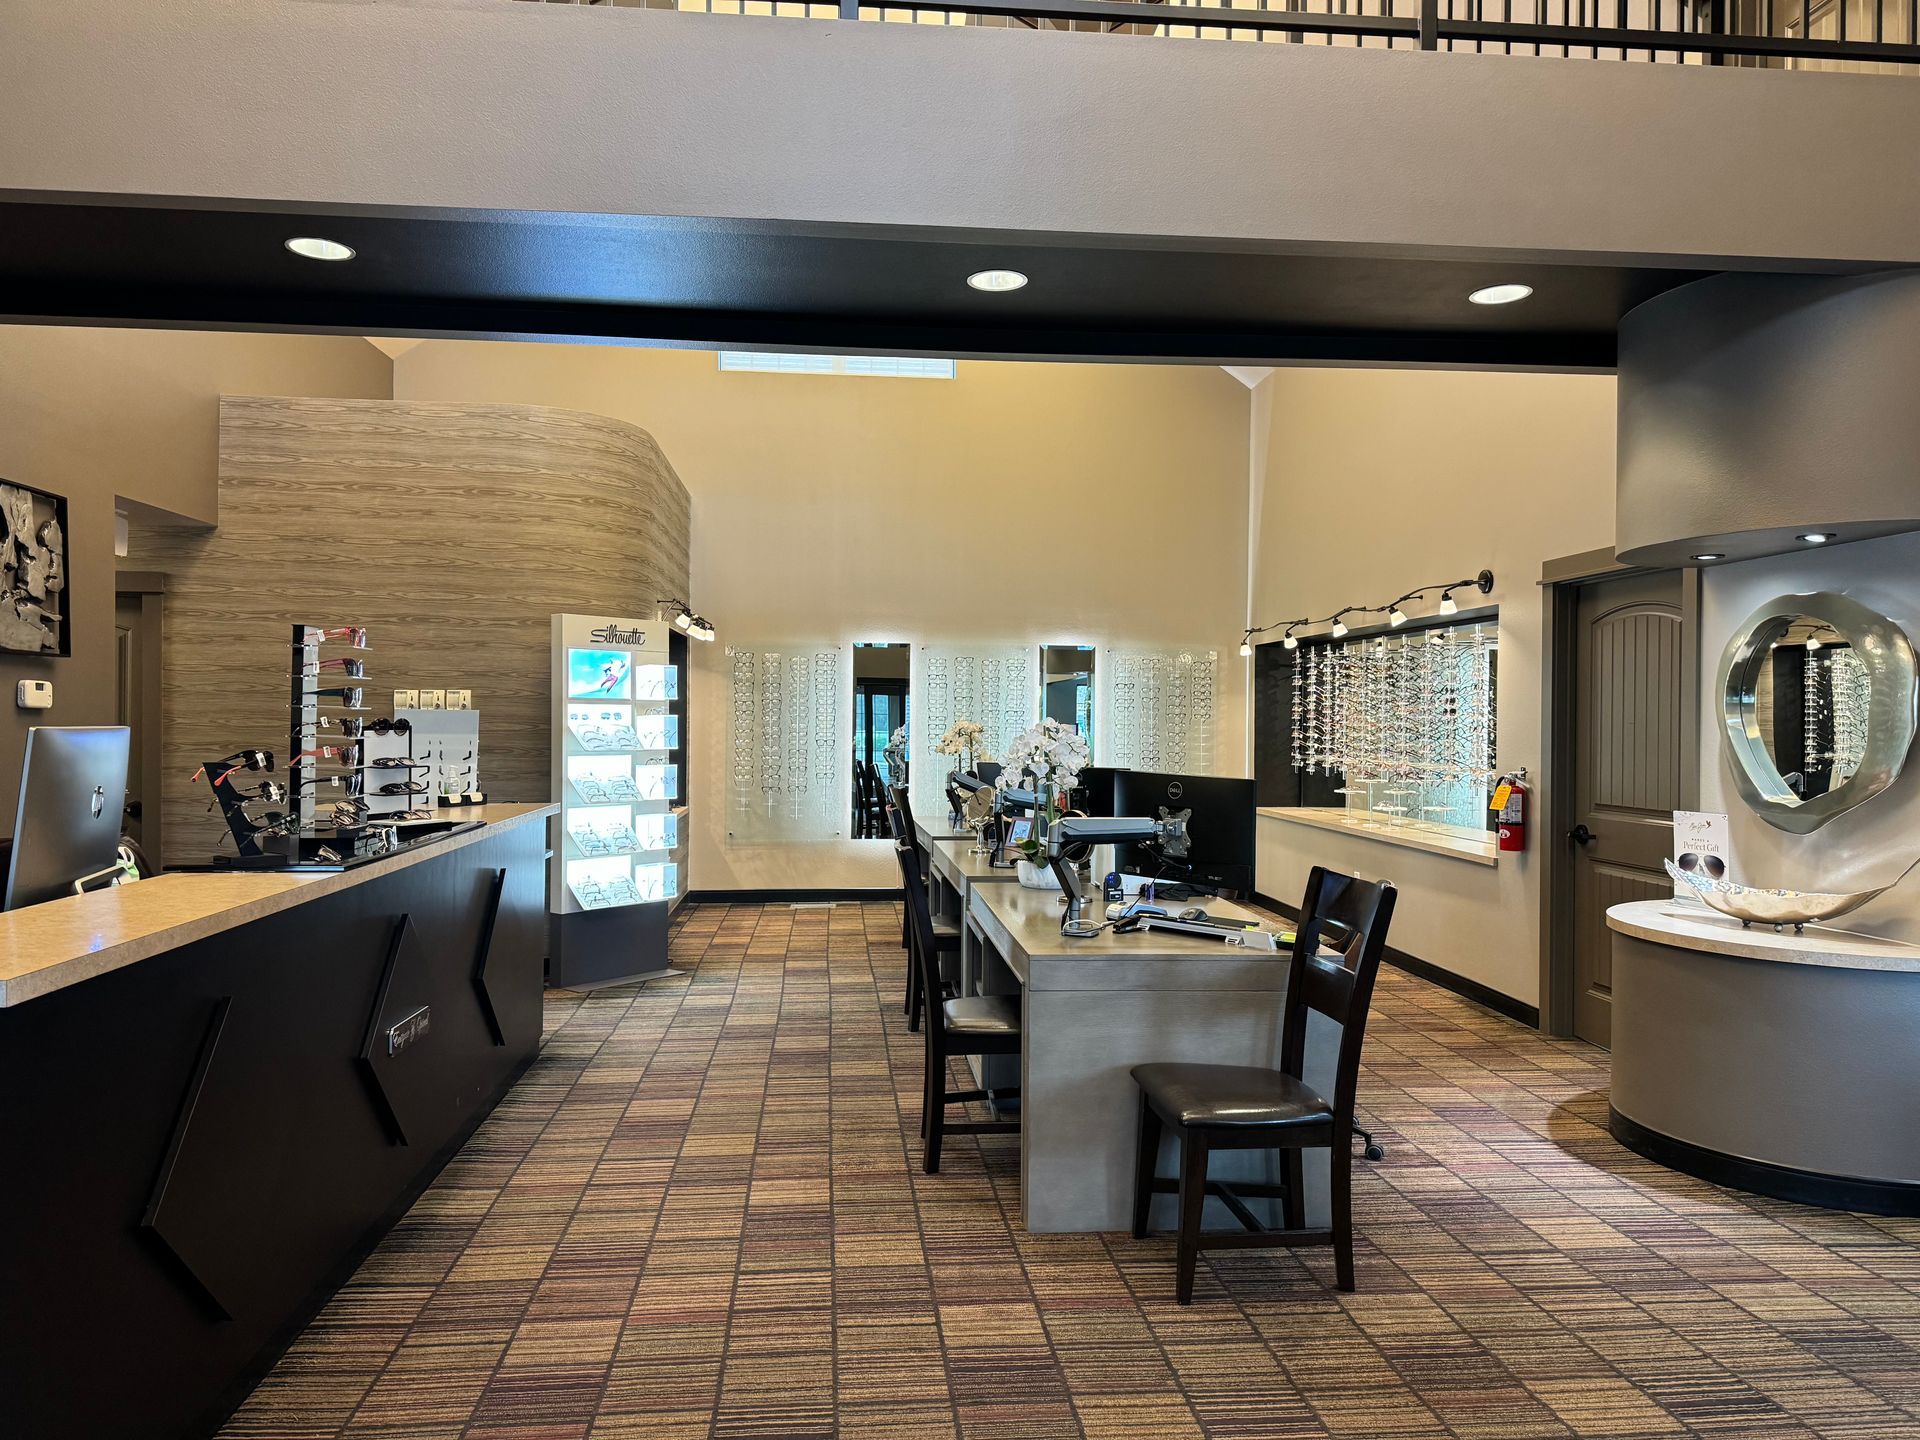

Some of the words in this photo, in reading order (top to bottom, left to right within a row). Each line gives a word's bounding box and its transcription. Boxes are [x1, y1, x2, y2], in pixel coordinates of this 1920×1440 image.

[590, 624, 646, 645] Silhouette
[1683, 841, 1706, 851] Perfect
[1706, 843, 1719, 853] Gift
